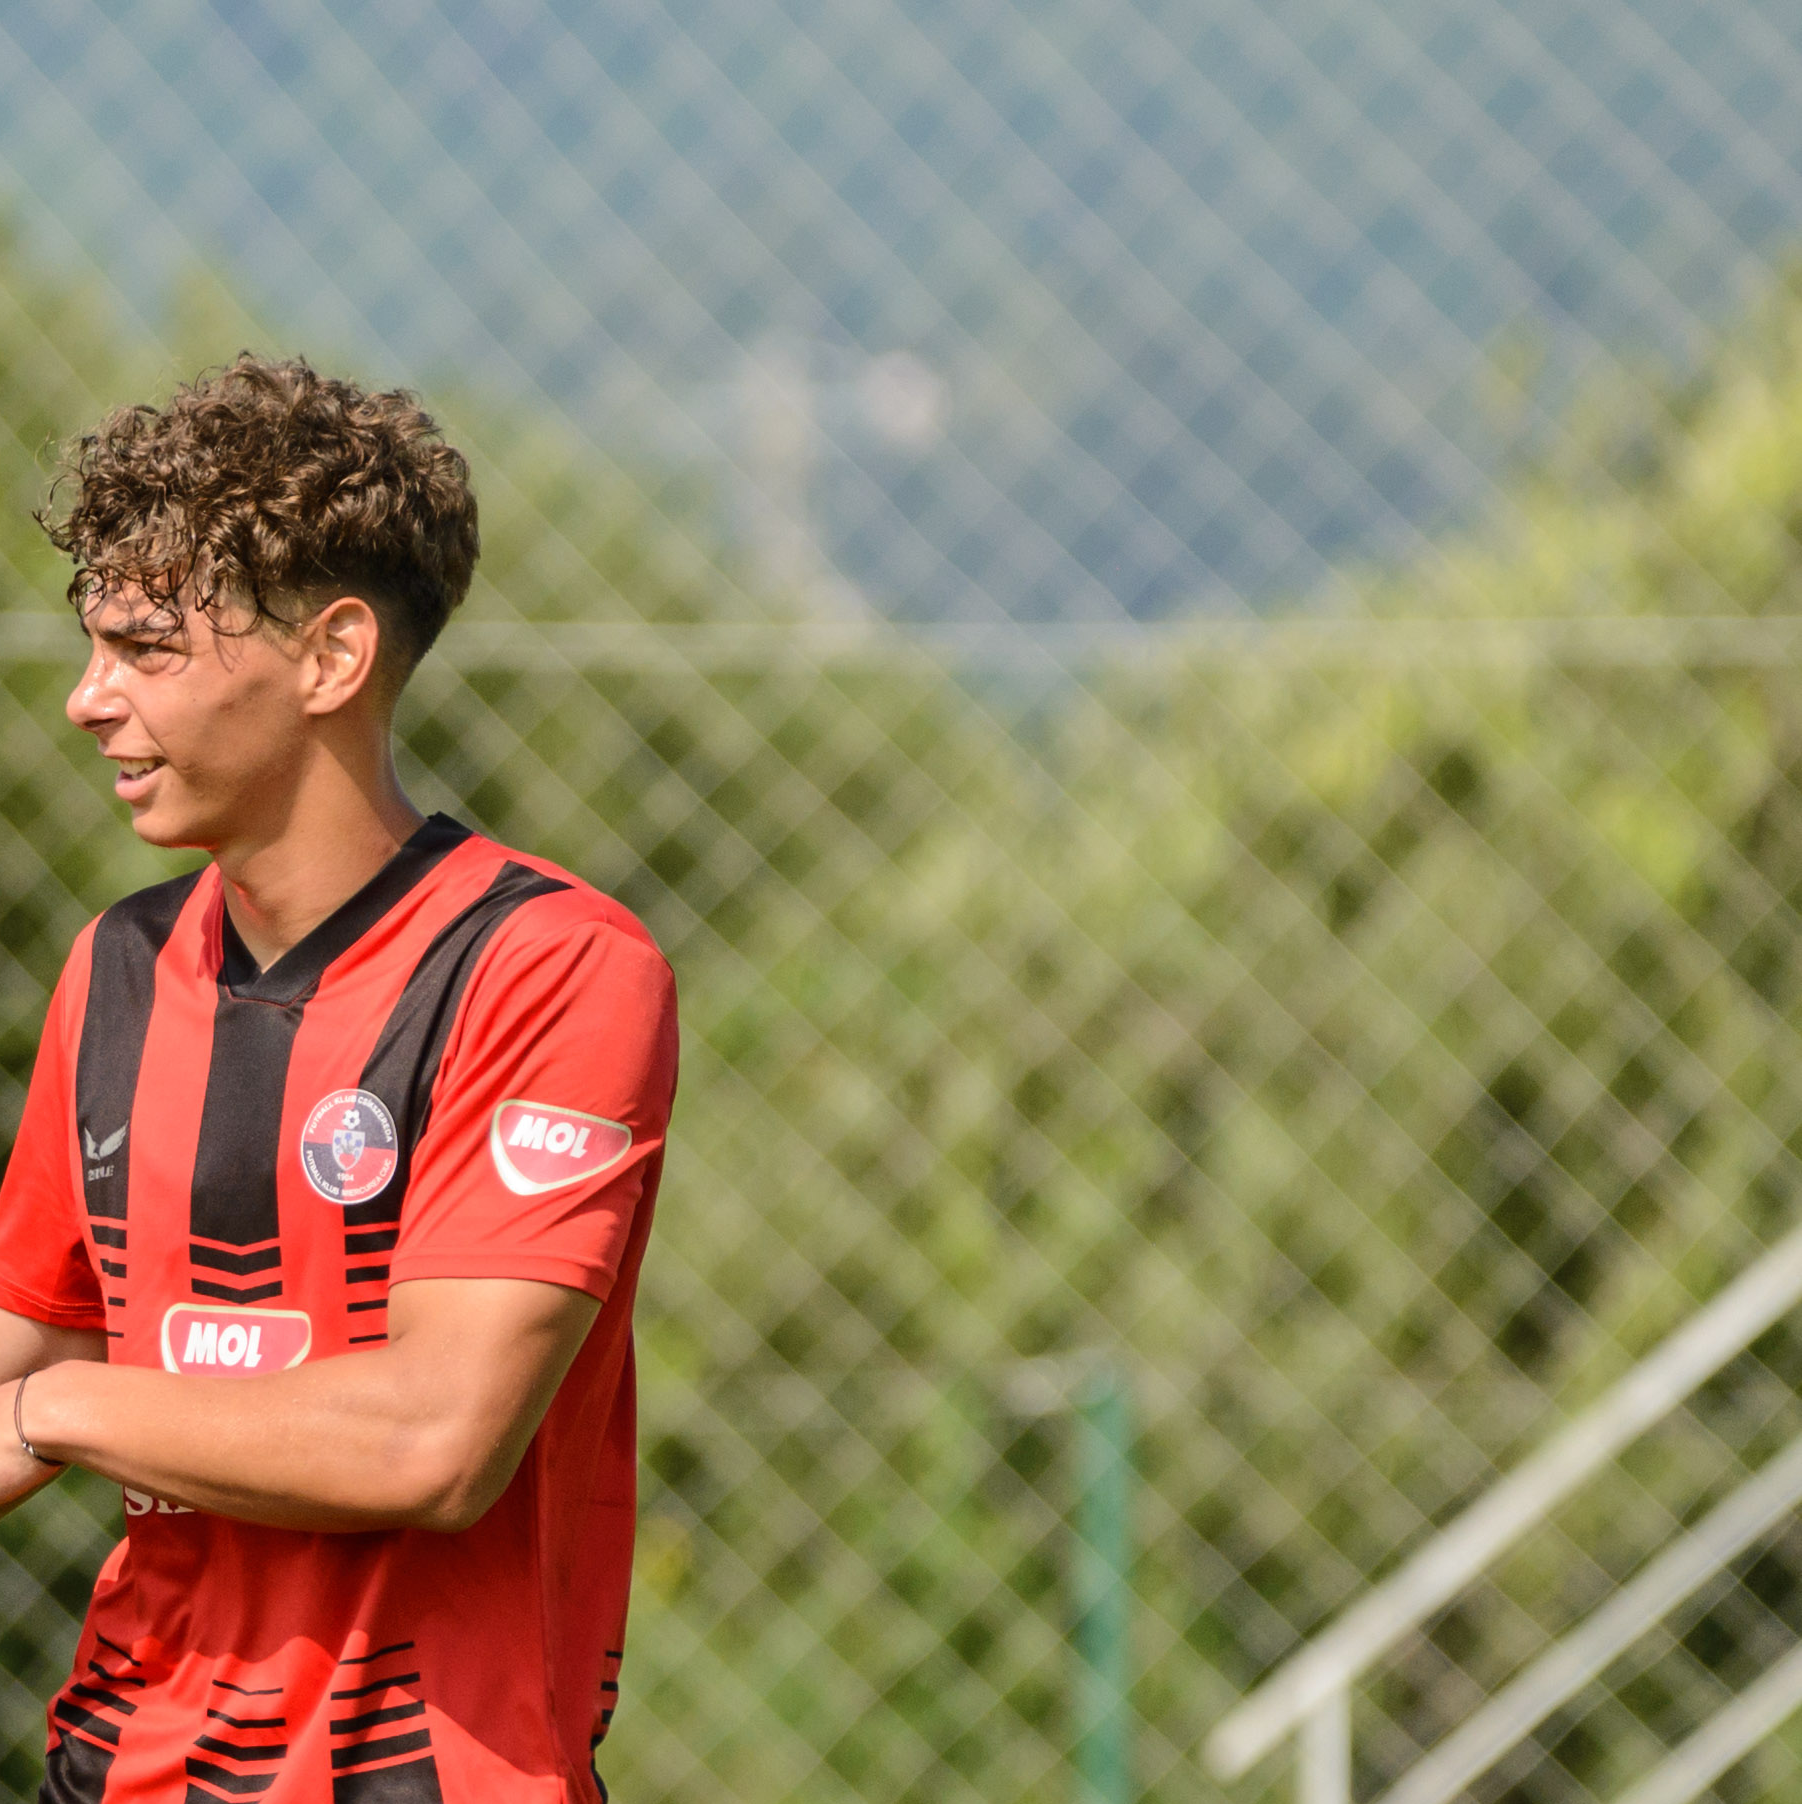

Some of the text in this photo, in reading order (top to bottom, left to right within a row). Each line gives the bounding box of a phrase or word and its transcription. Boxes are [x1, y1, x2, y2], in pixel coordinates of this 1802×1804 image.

[334, 1095, 357, 1105] KLUB
[507, 1114, 590, 1159] MOL
[183, 1322, 265, 1370] MOL
